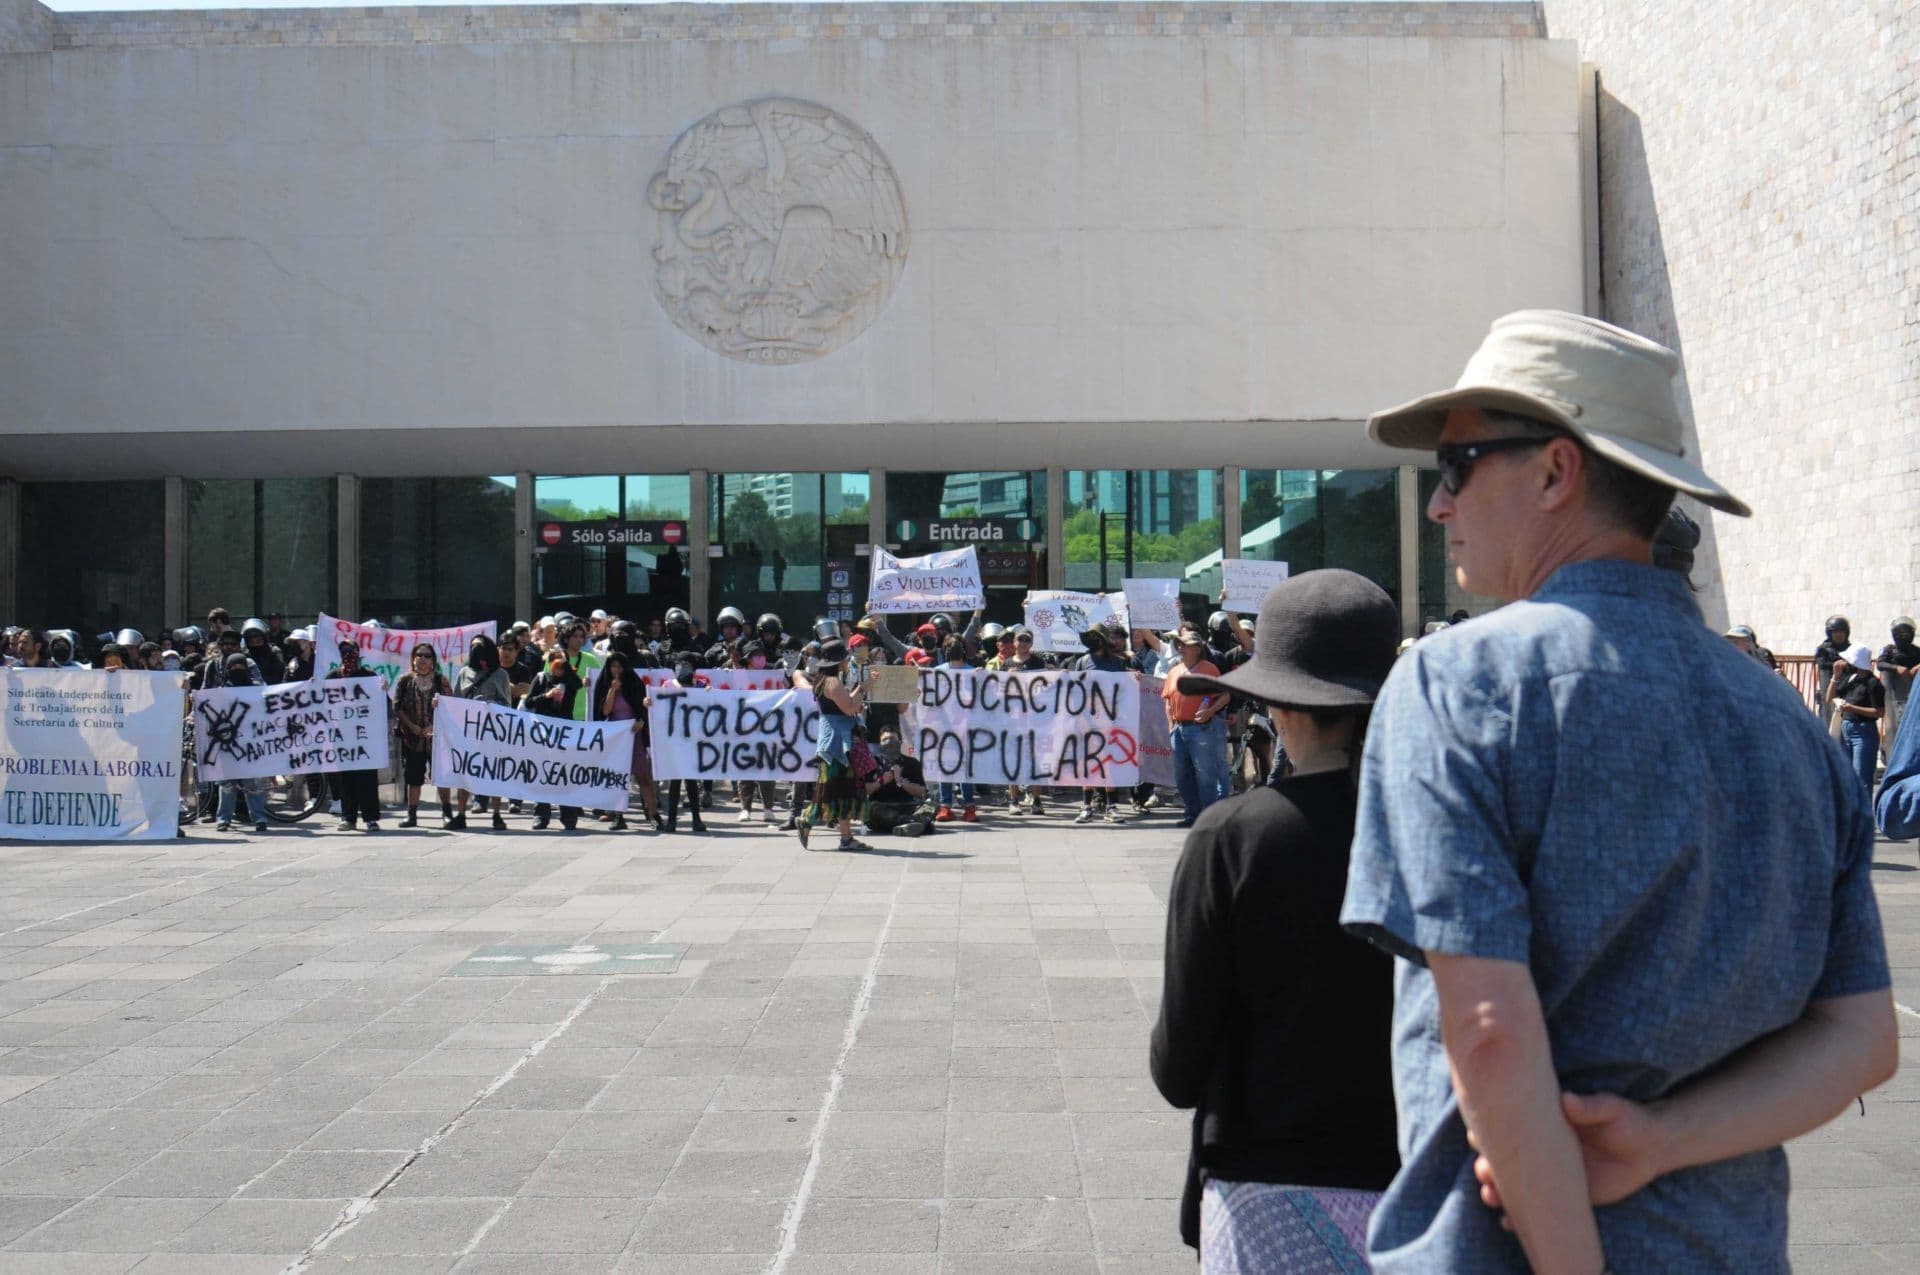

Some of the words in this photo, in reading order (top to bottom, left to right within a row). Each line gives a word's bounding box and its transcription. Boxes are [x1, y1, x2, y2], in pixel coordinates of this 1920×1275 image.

[572, 529, 604, 543] Sólo
[607, 529, 653, 543] Salida
[929, 522, 1003, 541] Entrada
[897, 576, 977, 591] VIOLENCIA
[906, 601, 922, 610] LA
[8, 688, 55, 699] Sindicato
[58, 689, 132, 701] Independiente
[264, 683, 370, 714] ESCUELA
[919, 670, 1120, 721] EDUCACIÓN
[14, 702, 26, 713] de
[30, 702, 97, 716] Trabajadores
[100, 704, 112, 714] de
[115, 704, 125, 714] la
[69, 719, 80, 728] de
[83, 719, 124, 729] Cultura
[251, 708, 339, 739] NACIONAL
[344, 705, 369, 720] DE
[356, 725, 368, 740] E
[464, 709, 525, 747] HASTA
[530, 720, 573, 751] QUE
[576, 728, 604, 752] LA
[290, 745, 370, 770] HISTORIA
[697, 740, 802, 774] DIGNO
[920, 728, 1106, 781] POPULAR
[93, 759, 177, 777] LABORAL
[451, 748, 538, 784] DIGNIDAD
[539, 760, 568, 786] SEA
[569, 763, 629, 791] COSTUMBRE
[5, 790, 27, 826] TE
[31, 791, 123, 828] DEFIENDE
